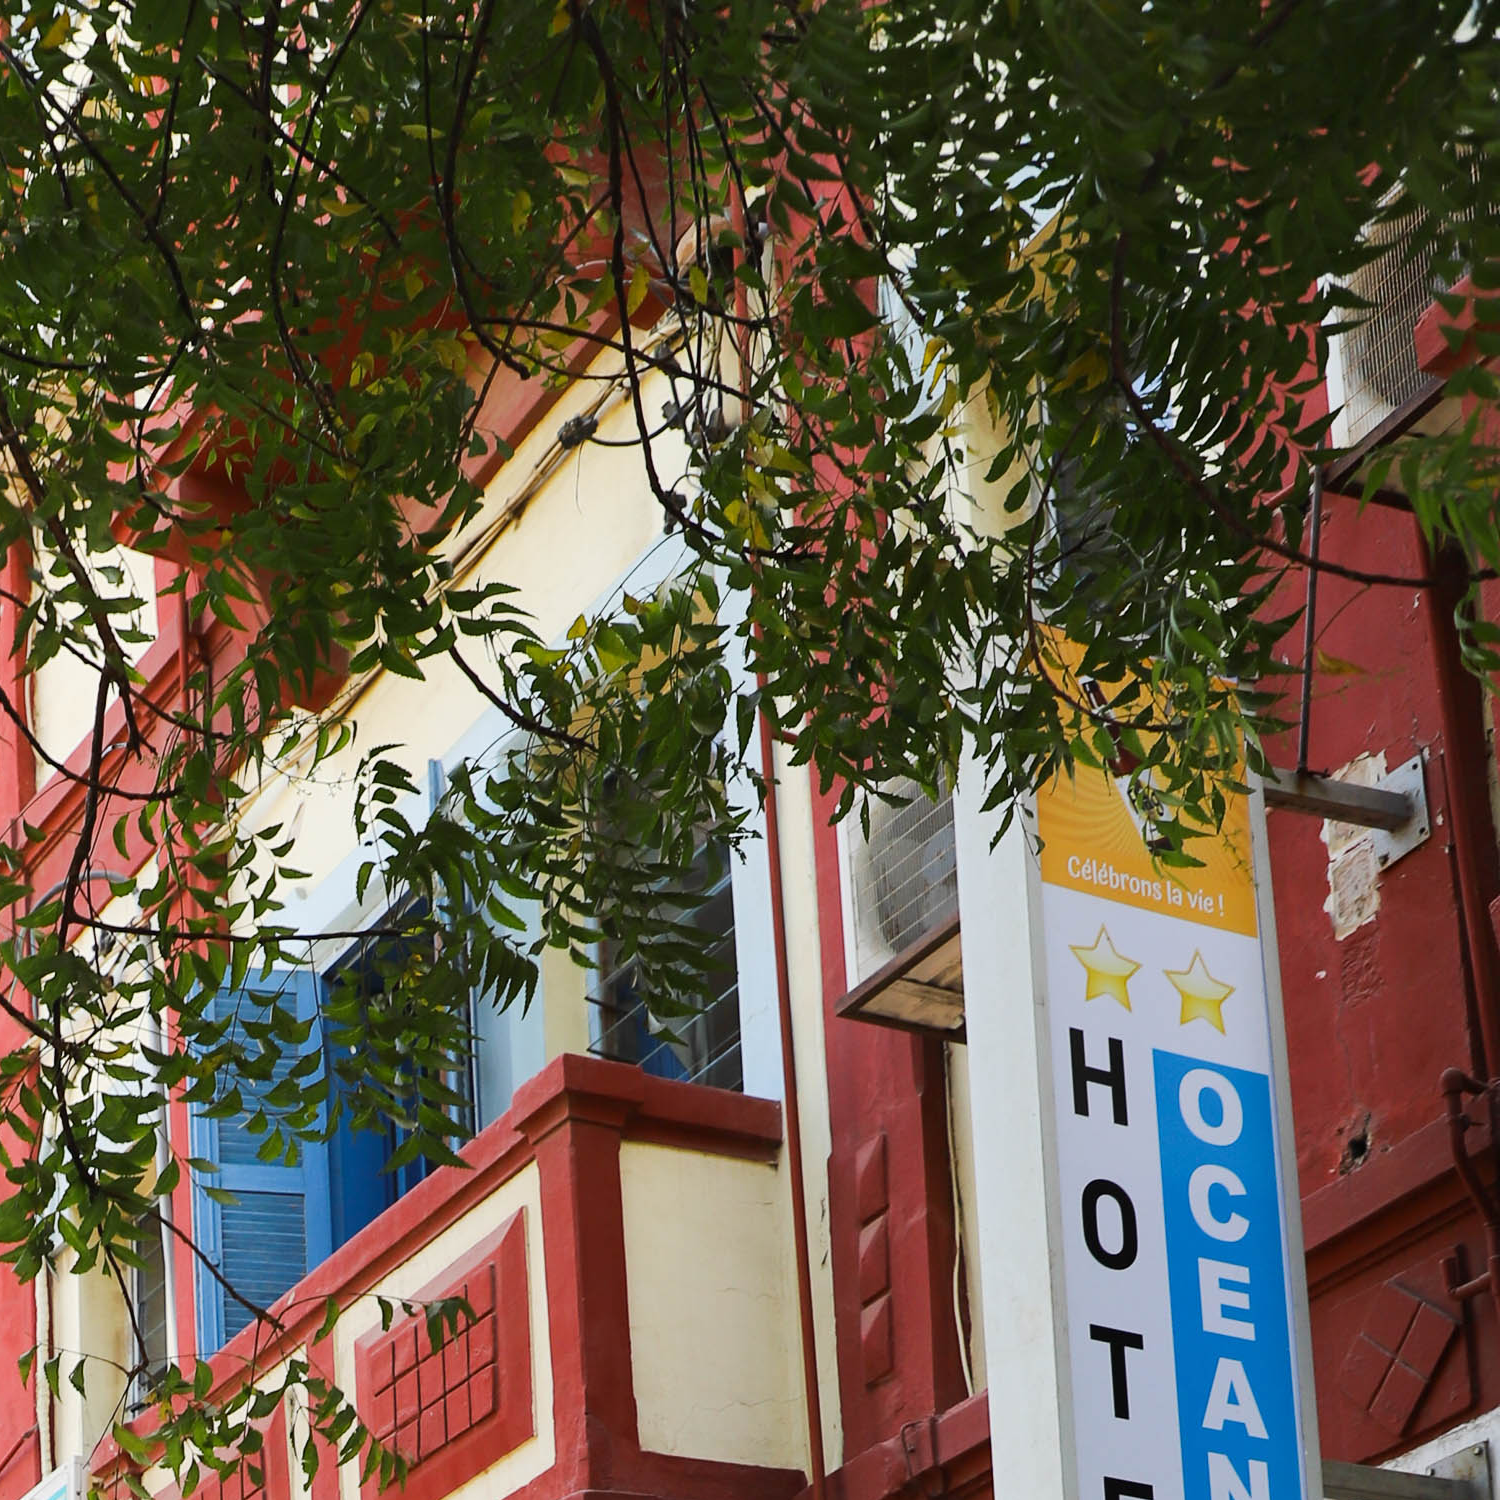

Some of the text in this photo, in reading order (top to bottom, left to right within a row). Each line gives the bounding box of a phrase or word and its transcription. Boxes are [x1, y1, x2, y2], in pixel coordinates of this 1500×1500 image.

[1067, 855, 1162, 901] Célébrons
[1166, 880, 1183, 906] la
[1187, 889, 1214, 914] vie
